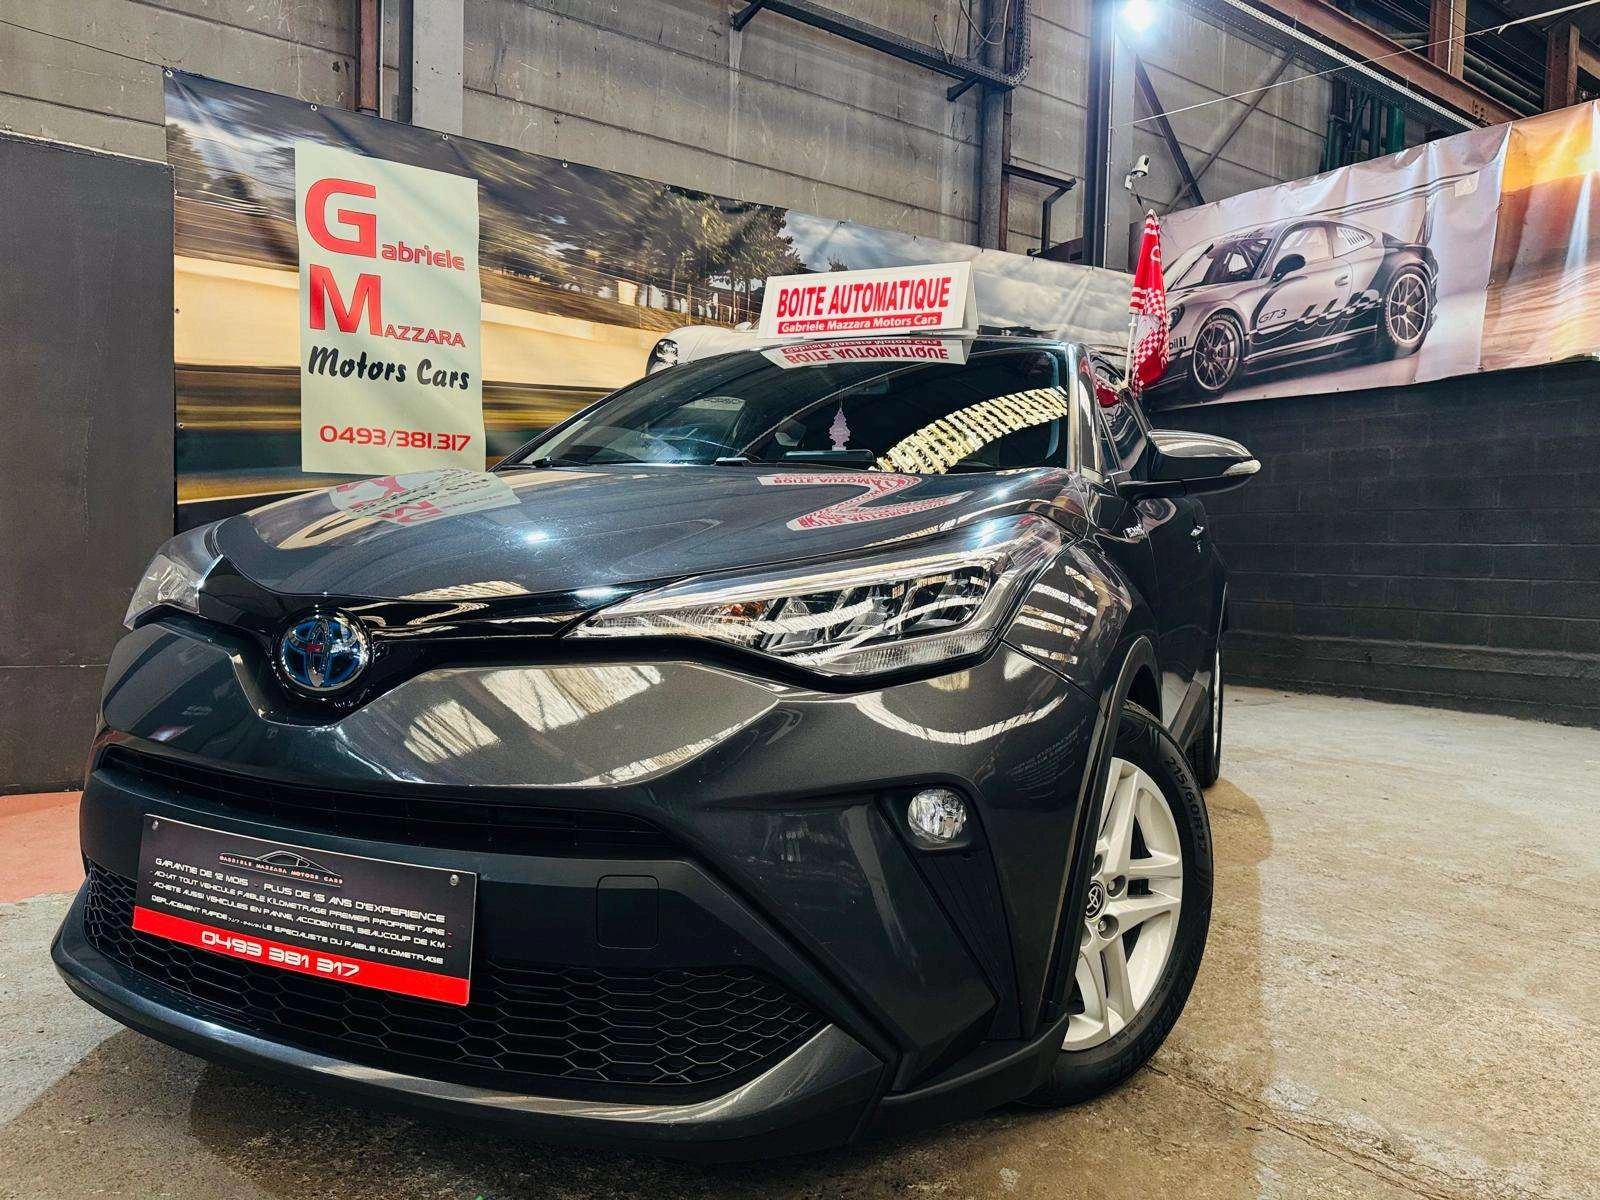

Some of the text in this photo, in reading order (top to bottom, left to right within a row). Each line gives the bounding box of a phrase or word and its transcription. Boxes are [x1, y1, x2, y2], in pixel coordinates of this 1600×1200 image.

[776, 276, 952, 318] BOITE AUTOMATIQUE
[1258, 308, 1287, 323] GT3
[781, 314, 938, 333] Gabriele Mazzara Motors Cars
[308, 345, 470, 390] Motors Cars
[319, 425, 471, 451] 0493/381.317
[154, 870, 177, 882] ACHAT
[178, 876, 198, 888] TOUT
[200, 882, 236, 896] VEHICULE
[328, 910, 370, 923] PREMIER
[155, 857, 198, 875] GARANTIE
[199, 868, 213, 878] DE
[225, 874, 249, 887] MOIS
[263, 883, 293, 896] PLUS
[295, 890, 311, 900] DE
[313, 893, 326, 903] 15
[328, 896, 352, 908] ANS
[355, 901, 446, 923] D'EXPERIENCE
[151, 894, 201, 914] DEPLACEMENT
[202, 908, 228, 921] RAPIDE
[262, 923, 273, 931] LE
[274, 926, 328, 943] SPECIALISTE
[329, 937, 342, 947] DU
[183, 888, 205, 900] AUSSI
[206, 895, 249, 911] VEHICULES
[250, 905, 262, 914] EN
[357, 927, 411, 942] BEAUCOUP
[413, 937, 428, 946] DE
[430, 940, 446, 949] KM
[201, 930, 360, 977] 0493 381 317
